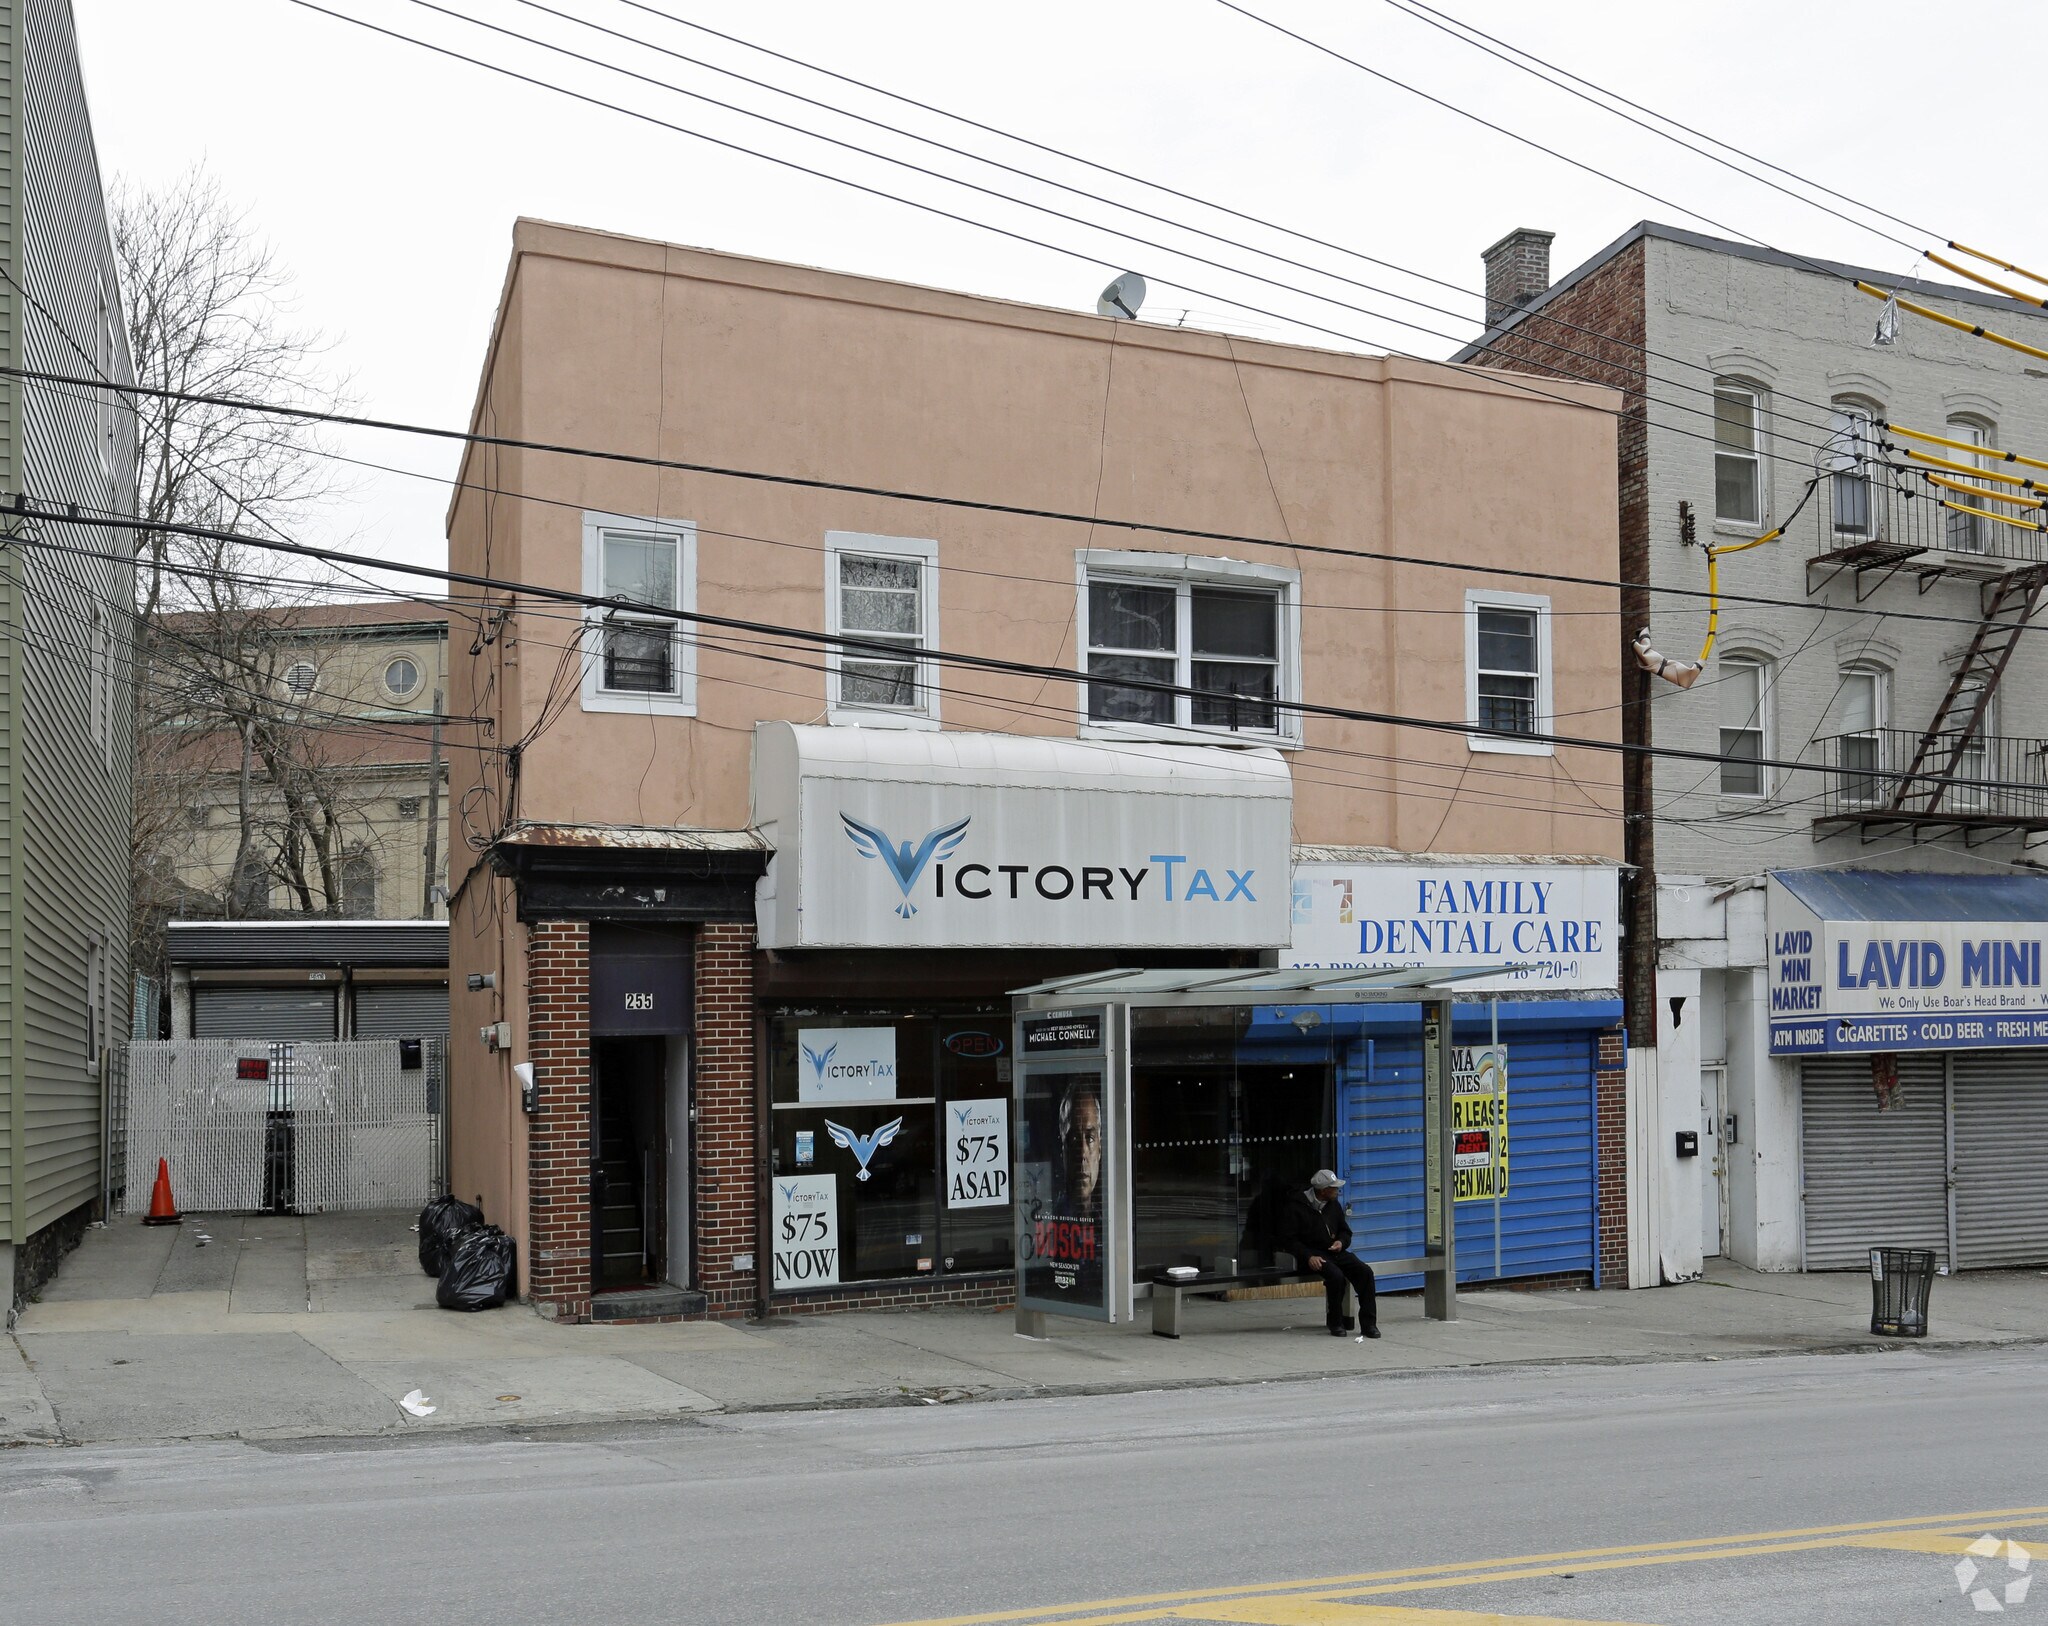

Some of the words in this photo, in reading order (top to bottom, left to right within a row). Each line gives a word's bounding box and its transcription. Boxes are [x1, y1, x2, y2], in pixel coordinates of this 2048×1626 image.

[1416, 879, 1554, 914] FAMILY
[1357, 919, 1503, 954] DENTAL
[1512, 919, 1603, 954] CARE
[1775, 930, 1813, 956] LAVID
[1781, 958, 1811, 983] MINI
[1837, 940, 1946, 990] LAVID
[1961, 940, 2042, 988] MINI
[626, 993, 652, 1009] 255
[1772, 985, 1822, 1011] MARKET
[1879, 997, 1895, 1009] We
[1898, 996, 1919, 1011] Only
[1923, 996, 1940, 1008] Use
[1943, 995, 1971, 1007] Boar's
[1974, 995, 1997, 1007] Head
[2000, 994, 2026, 1006] Brand
[950, 1036, 998, 1053] OPEN
[1029, 1031, 1057, 1043] MICHAEL
[1059, 1029, 1095, 1040] CONNELLY
[1773, 1030, 1793, 1047] ATM
[1795, 1029, 1824, 1046] INSIDE
[1836, 1024, 1908, 1043] CIGARETTES
[1921, 1023, 1953, 1040] COLD
[1957, 1022, 1984, 1039] BEER
[1996, 1021, 2030, 1038] FRESH
[1452, 1074, 1481, 1094] MES
[1466, 1099, 1505, 1128] LEASE
[956, 1134, 999, 1165] $75
[1457, 1142, 1488, 1153] RENT
[1462, 1133, 1483, 1144] FOR
[951, 1169, 1007, 1200] ASAP
[1476, 1166, 1506, 1196] WAD
[781, 1211, 828, 1244] $75
[774, 1248, 837, 1281] NOW
